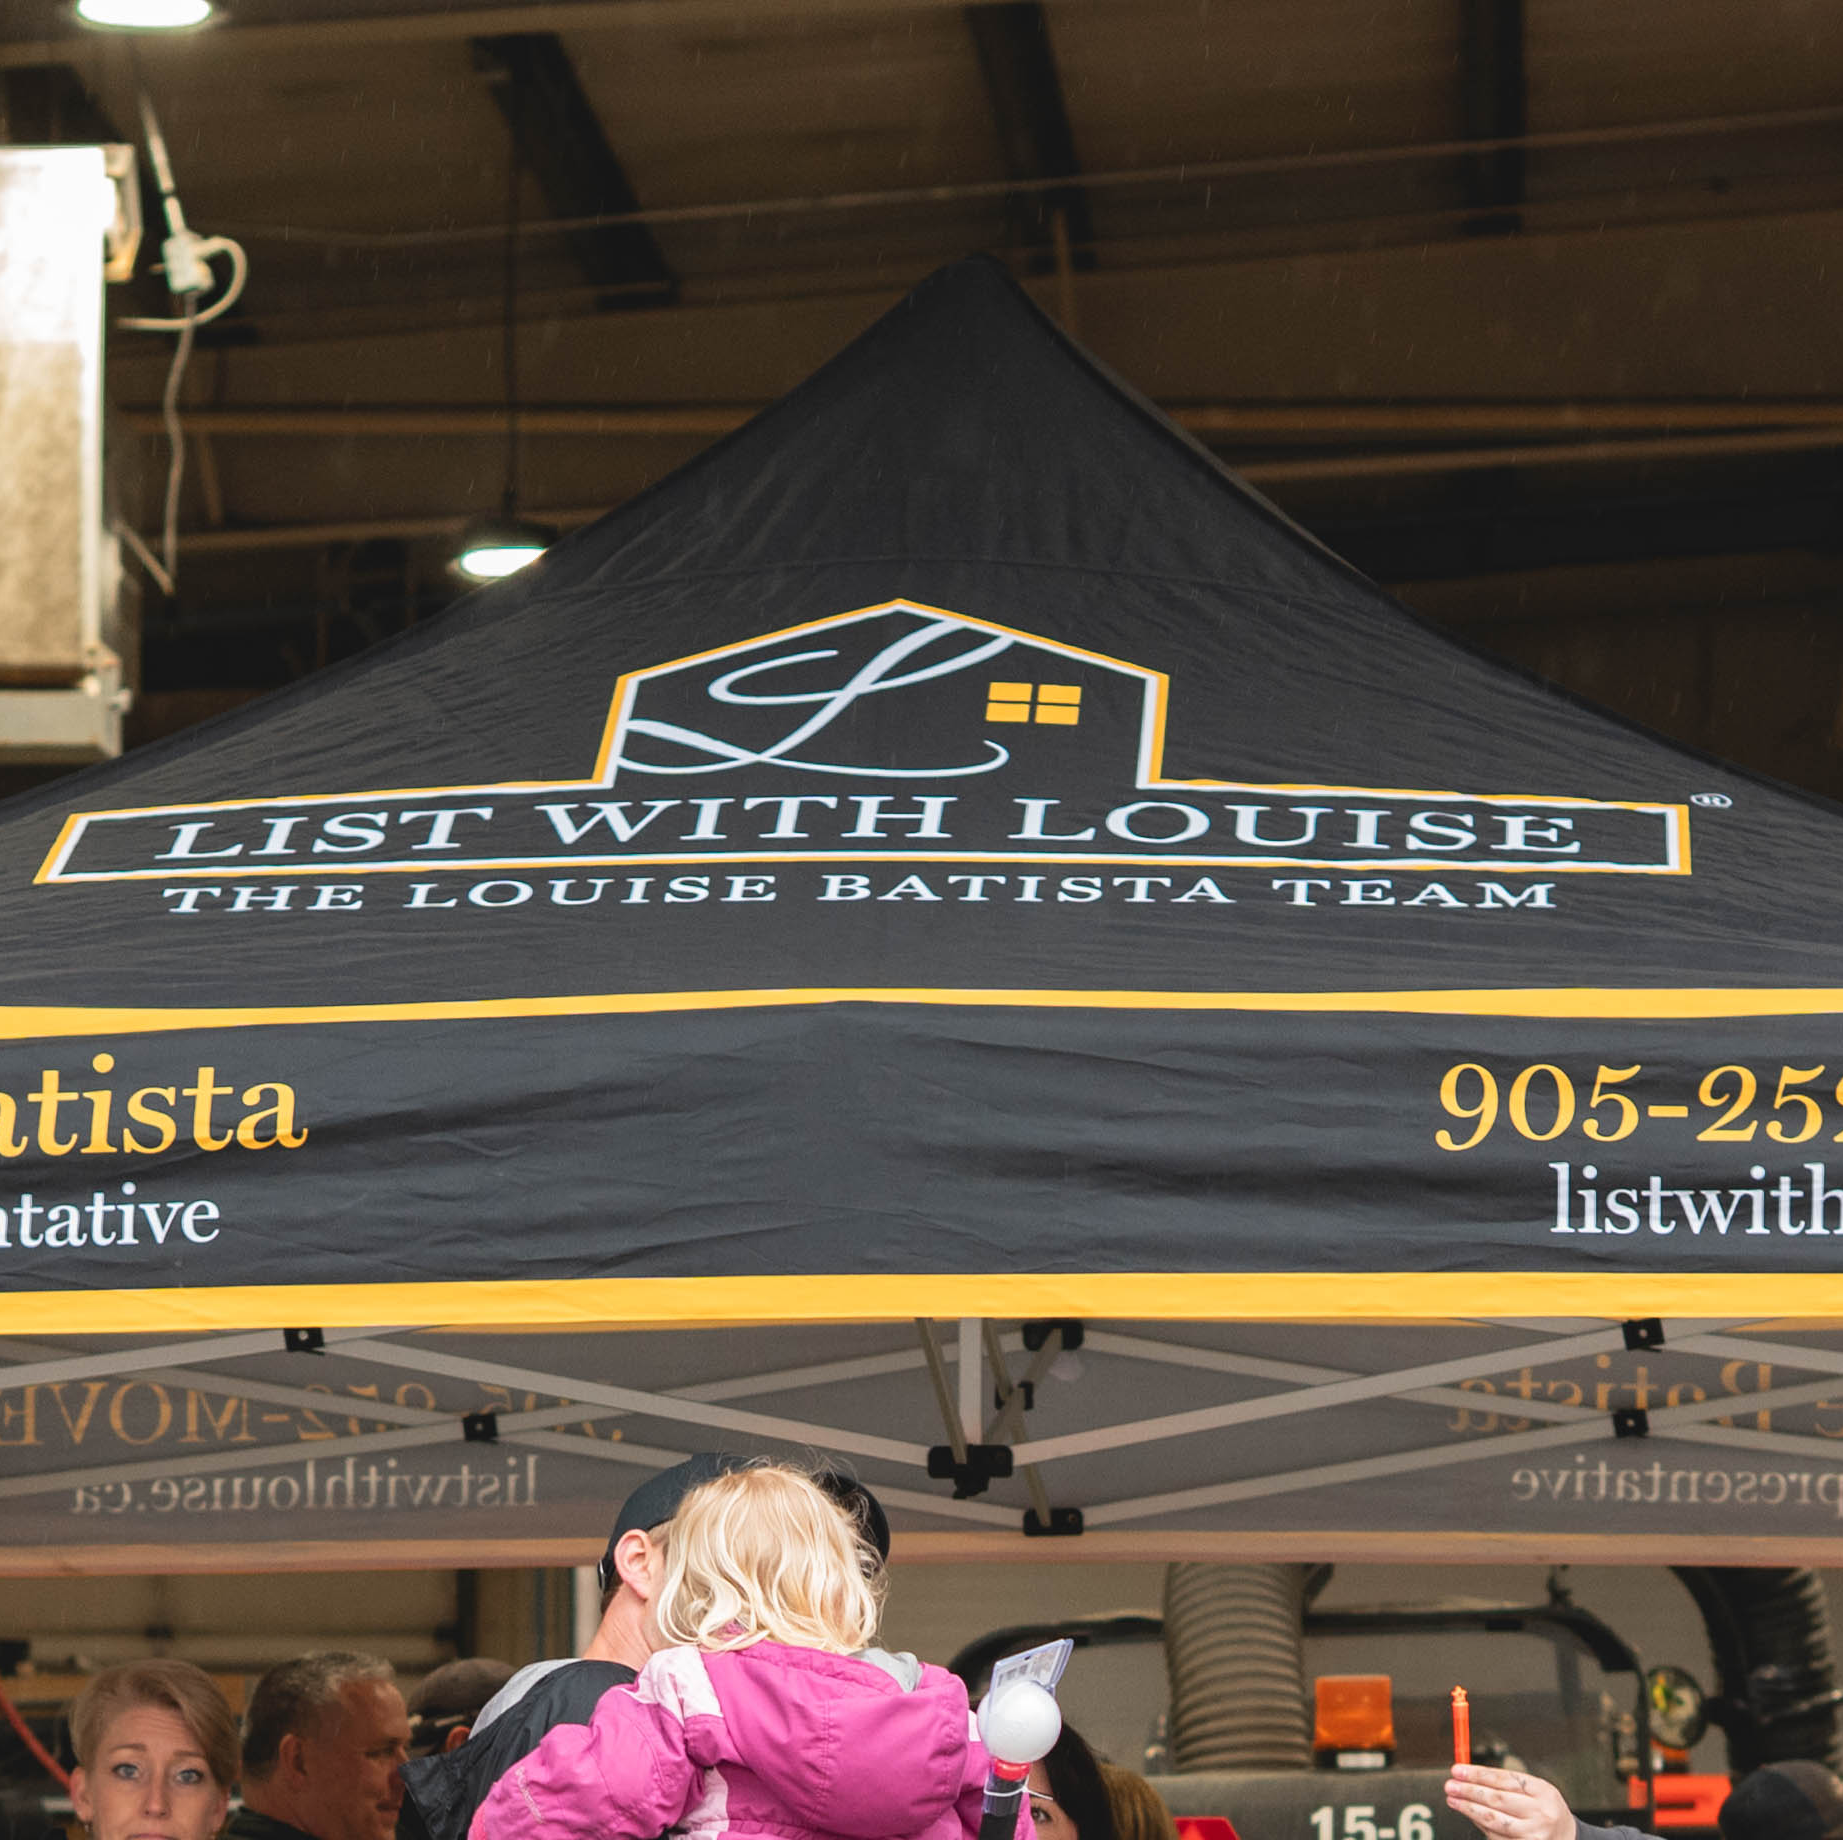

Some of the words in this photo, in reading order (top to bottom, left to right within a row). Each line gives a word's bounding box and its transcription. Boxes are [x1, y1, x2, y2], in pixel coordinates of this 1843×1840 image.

[155, 806, 493, 861] LIST
[535, 793, 958, 846] WITH
[1007, 797, 1581, 855] LOUISE
[163, 884, 364, 913] THE
[403, 876, 778, 910] LOUISE
[817, 873, 1237, 905] BATISTA
[1271, 877, 1558, 909] TEAM
